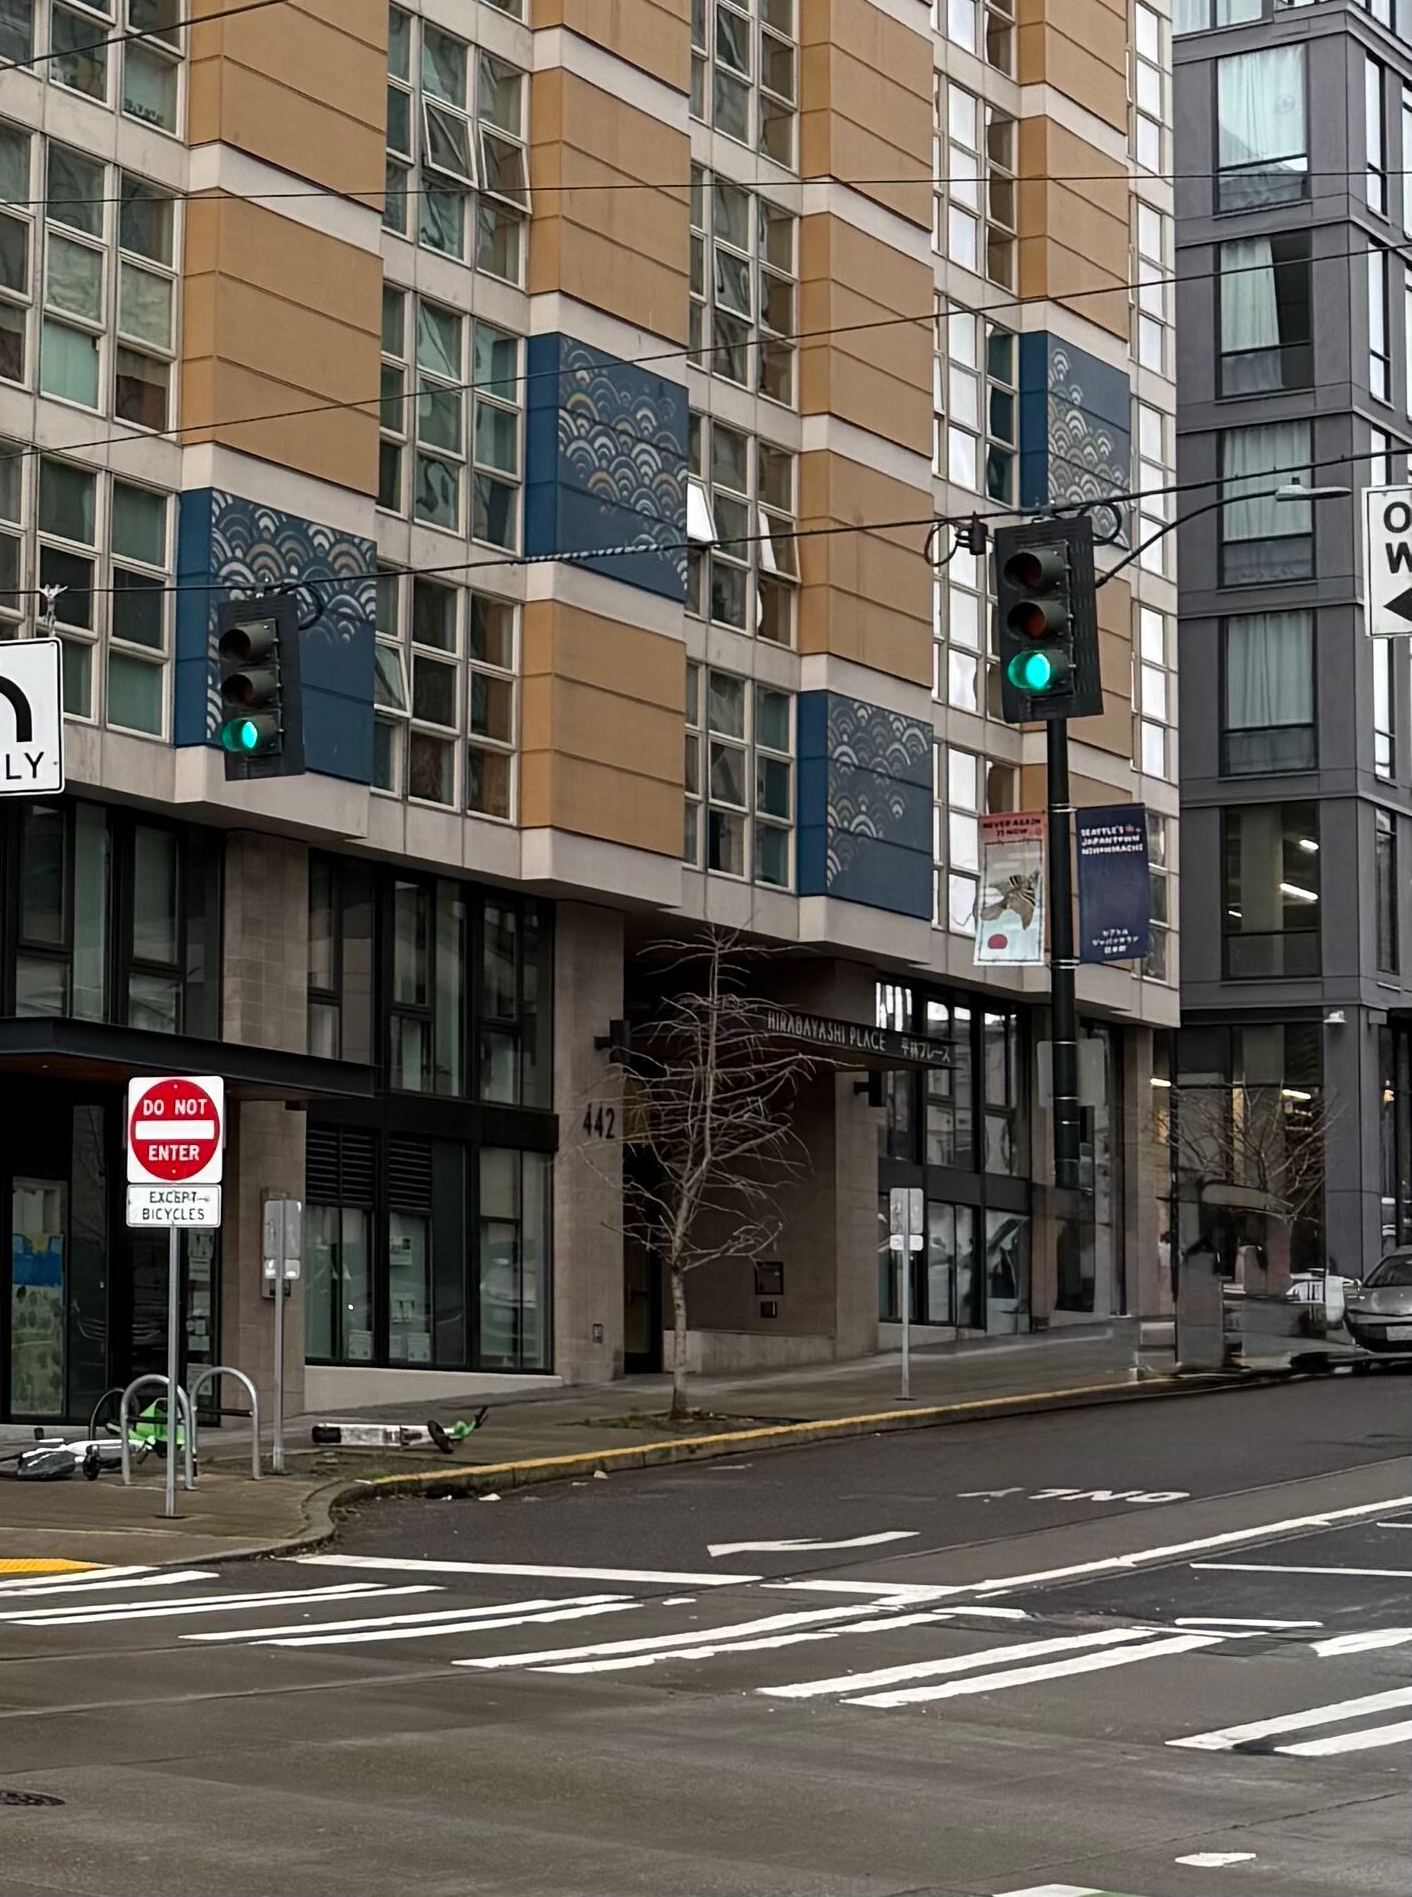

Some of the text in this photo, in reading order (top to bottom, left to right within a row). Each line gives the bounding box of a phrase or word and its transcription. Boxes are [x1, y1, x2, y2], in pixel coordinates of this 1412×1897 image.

[767, 1011, 886, 1051] HIRABAYASHI PLACE
[142, 1099, 208, 1116] DO NOT
[583, 1103, 615, 1139] 442
[148, 1145, 200, 1161] ENTER
[149, 1191, 197, 1203] EXCEPT
[142, 1208, 205, 1220] BICYCLES
[957, 1487, 1191, 1503] ONLY
